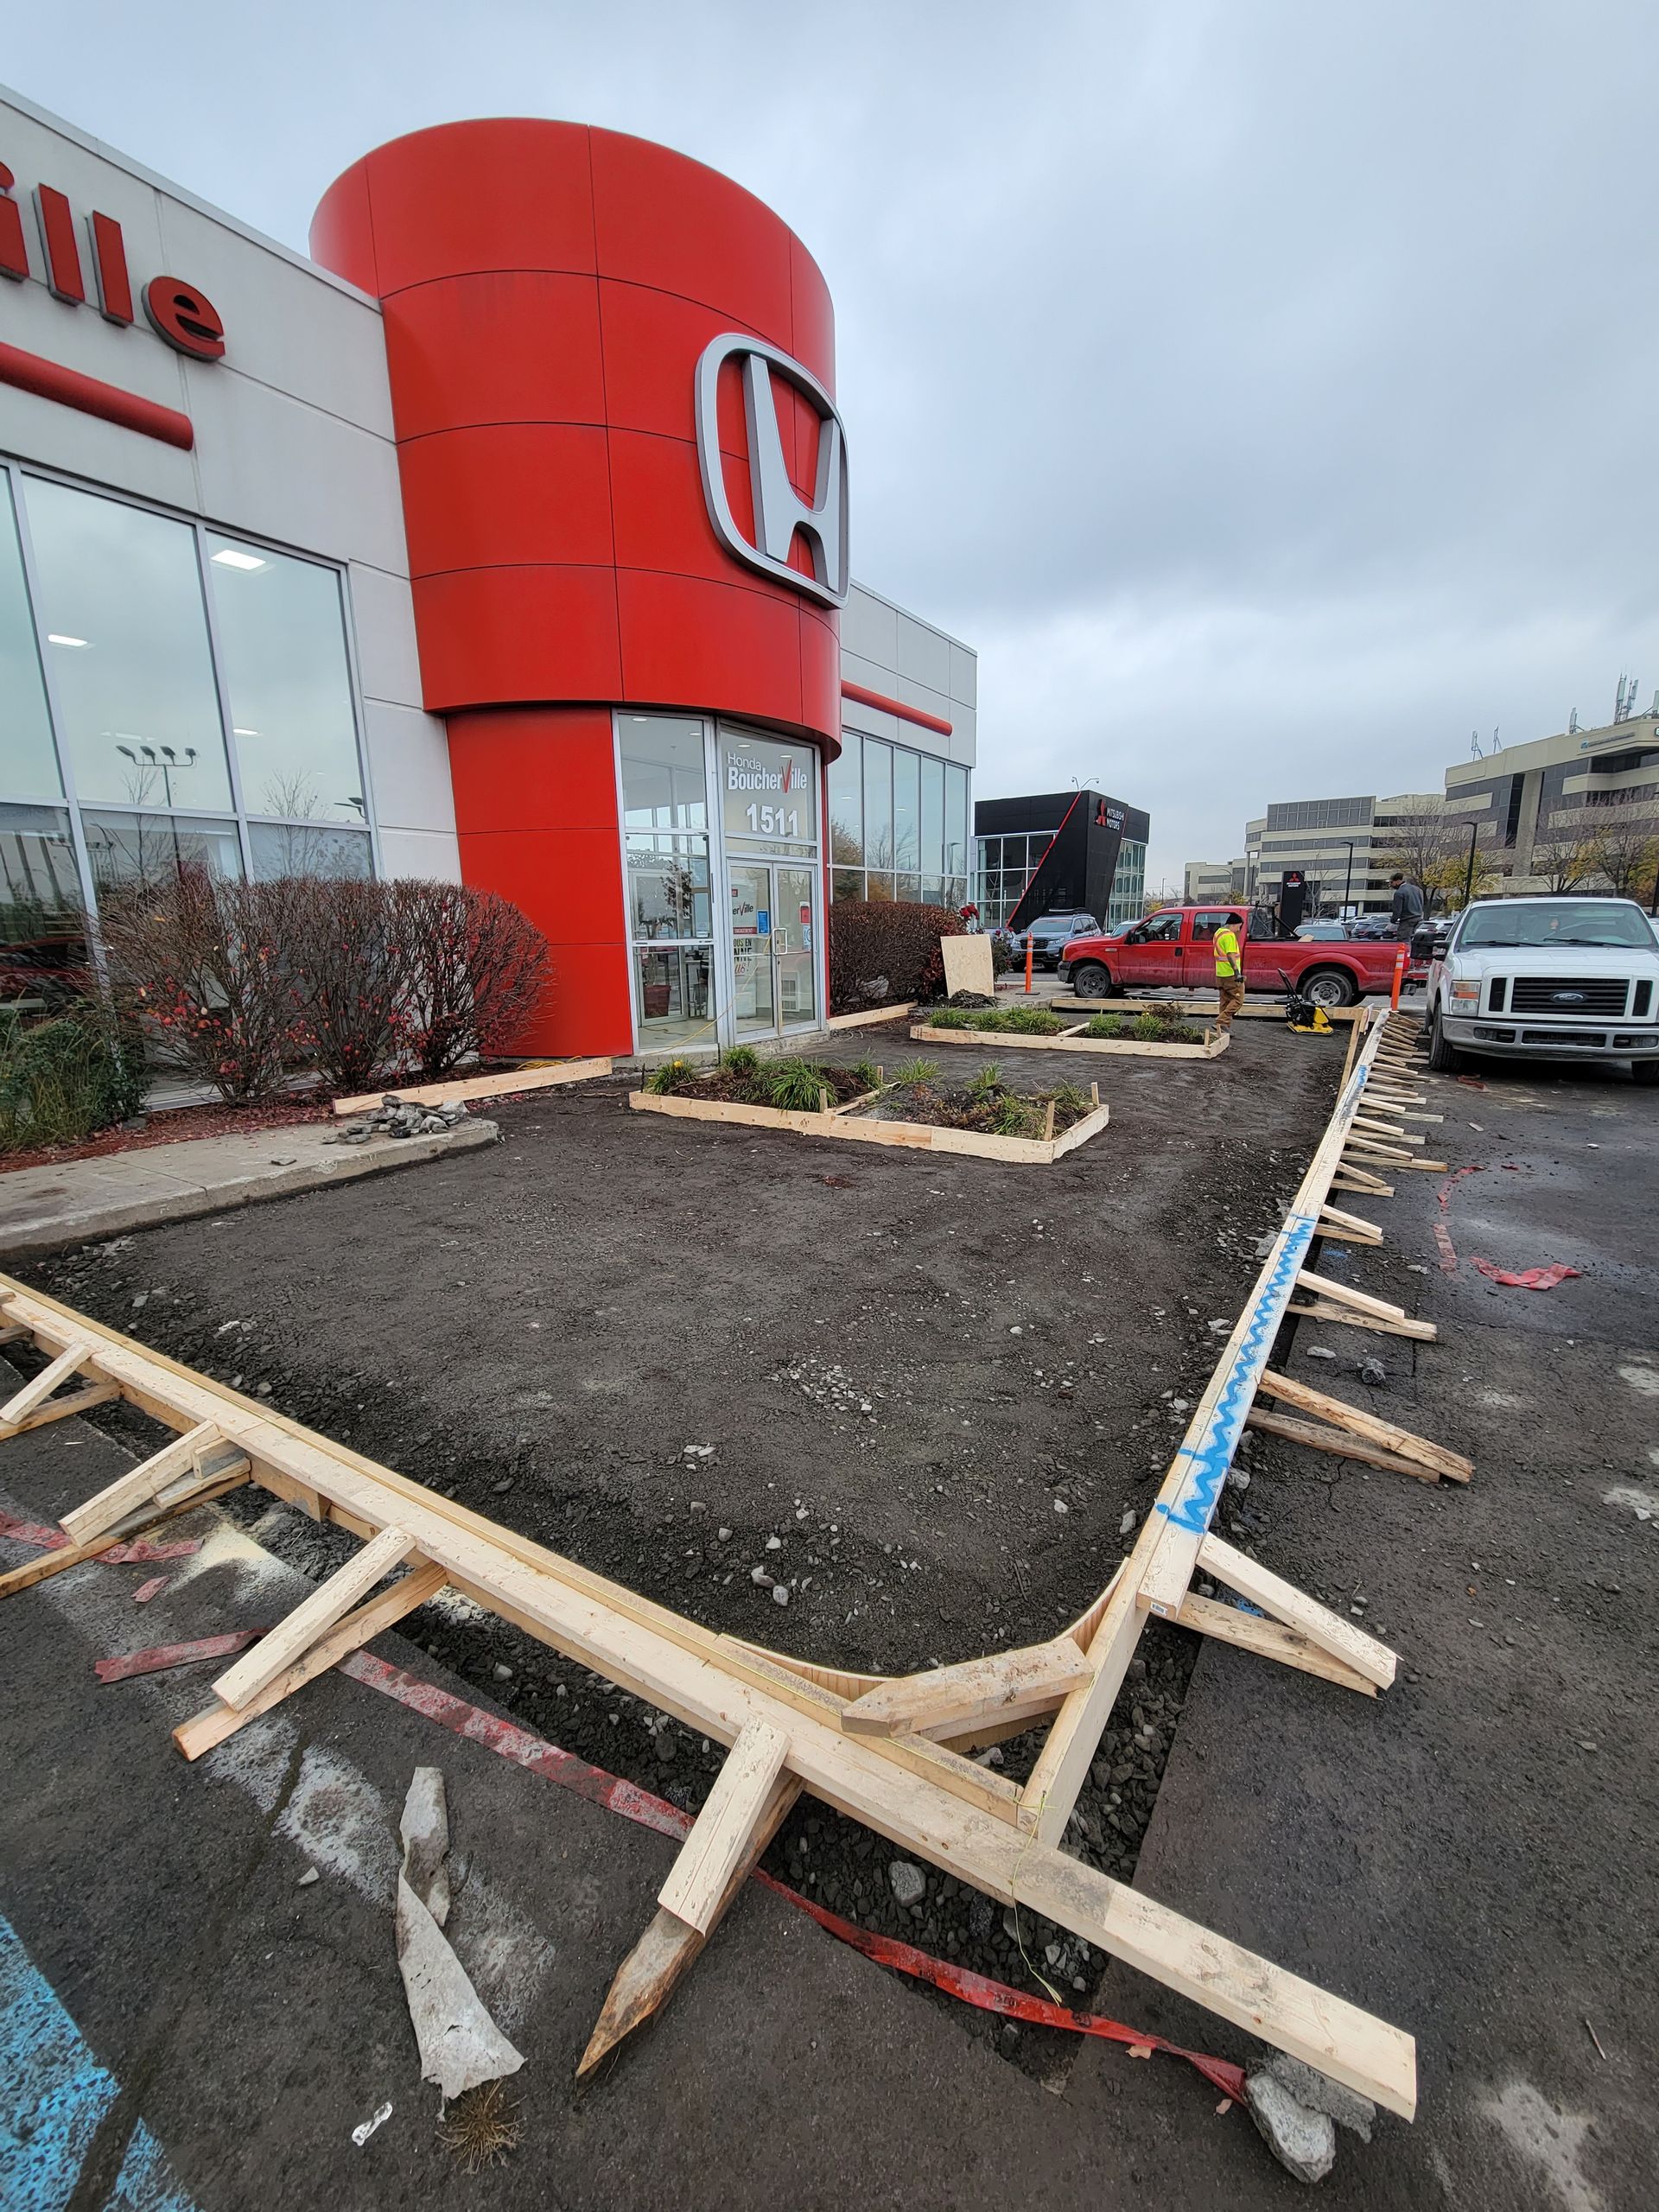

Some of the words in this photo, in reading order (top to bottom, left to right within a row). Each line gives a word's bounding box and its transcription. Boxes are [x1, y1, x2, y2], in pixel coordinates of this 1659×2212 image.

[728, 751, 761, 771] Honda
[728, 760, 807, 793] BoucherVille
[747, 804, 798, 836] 1511
